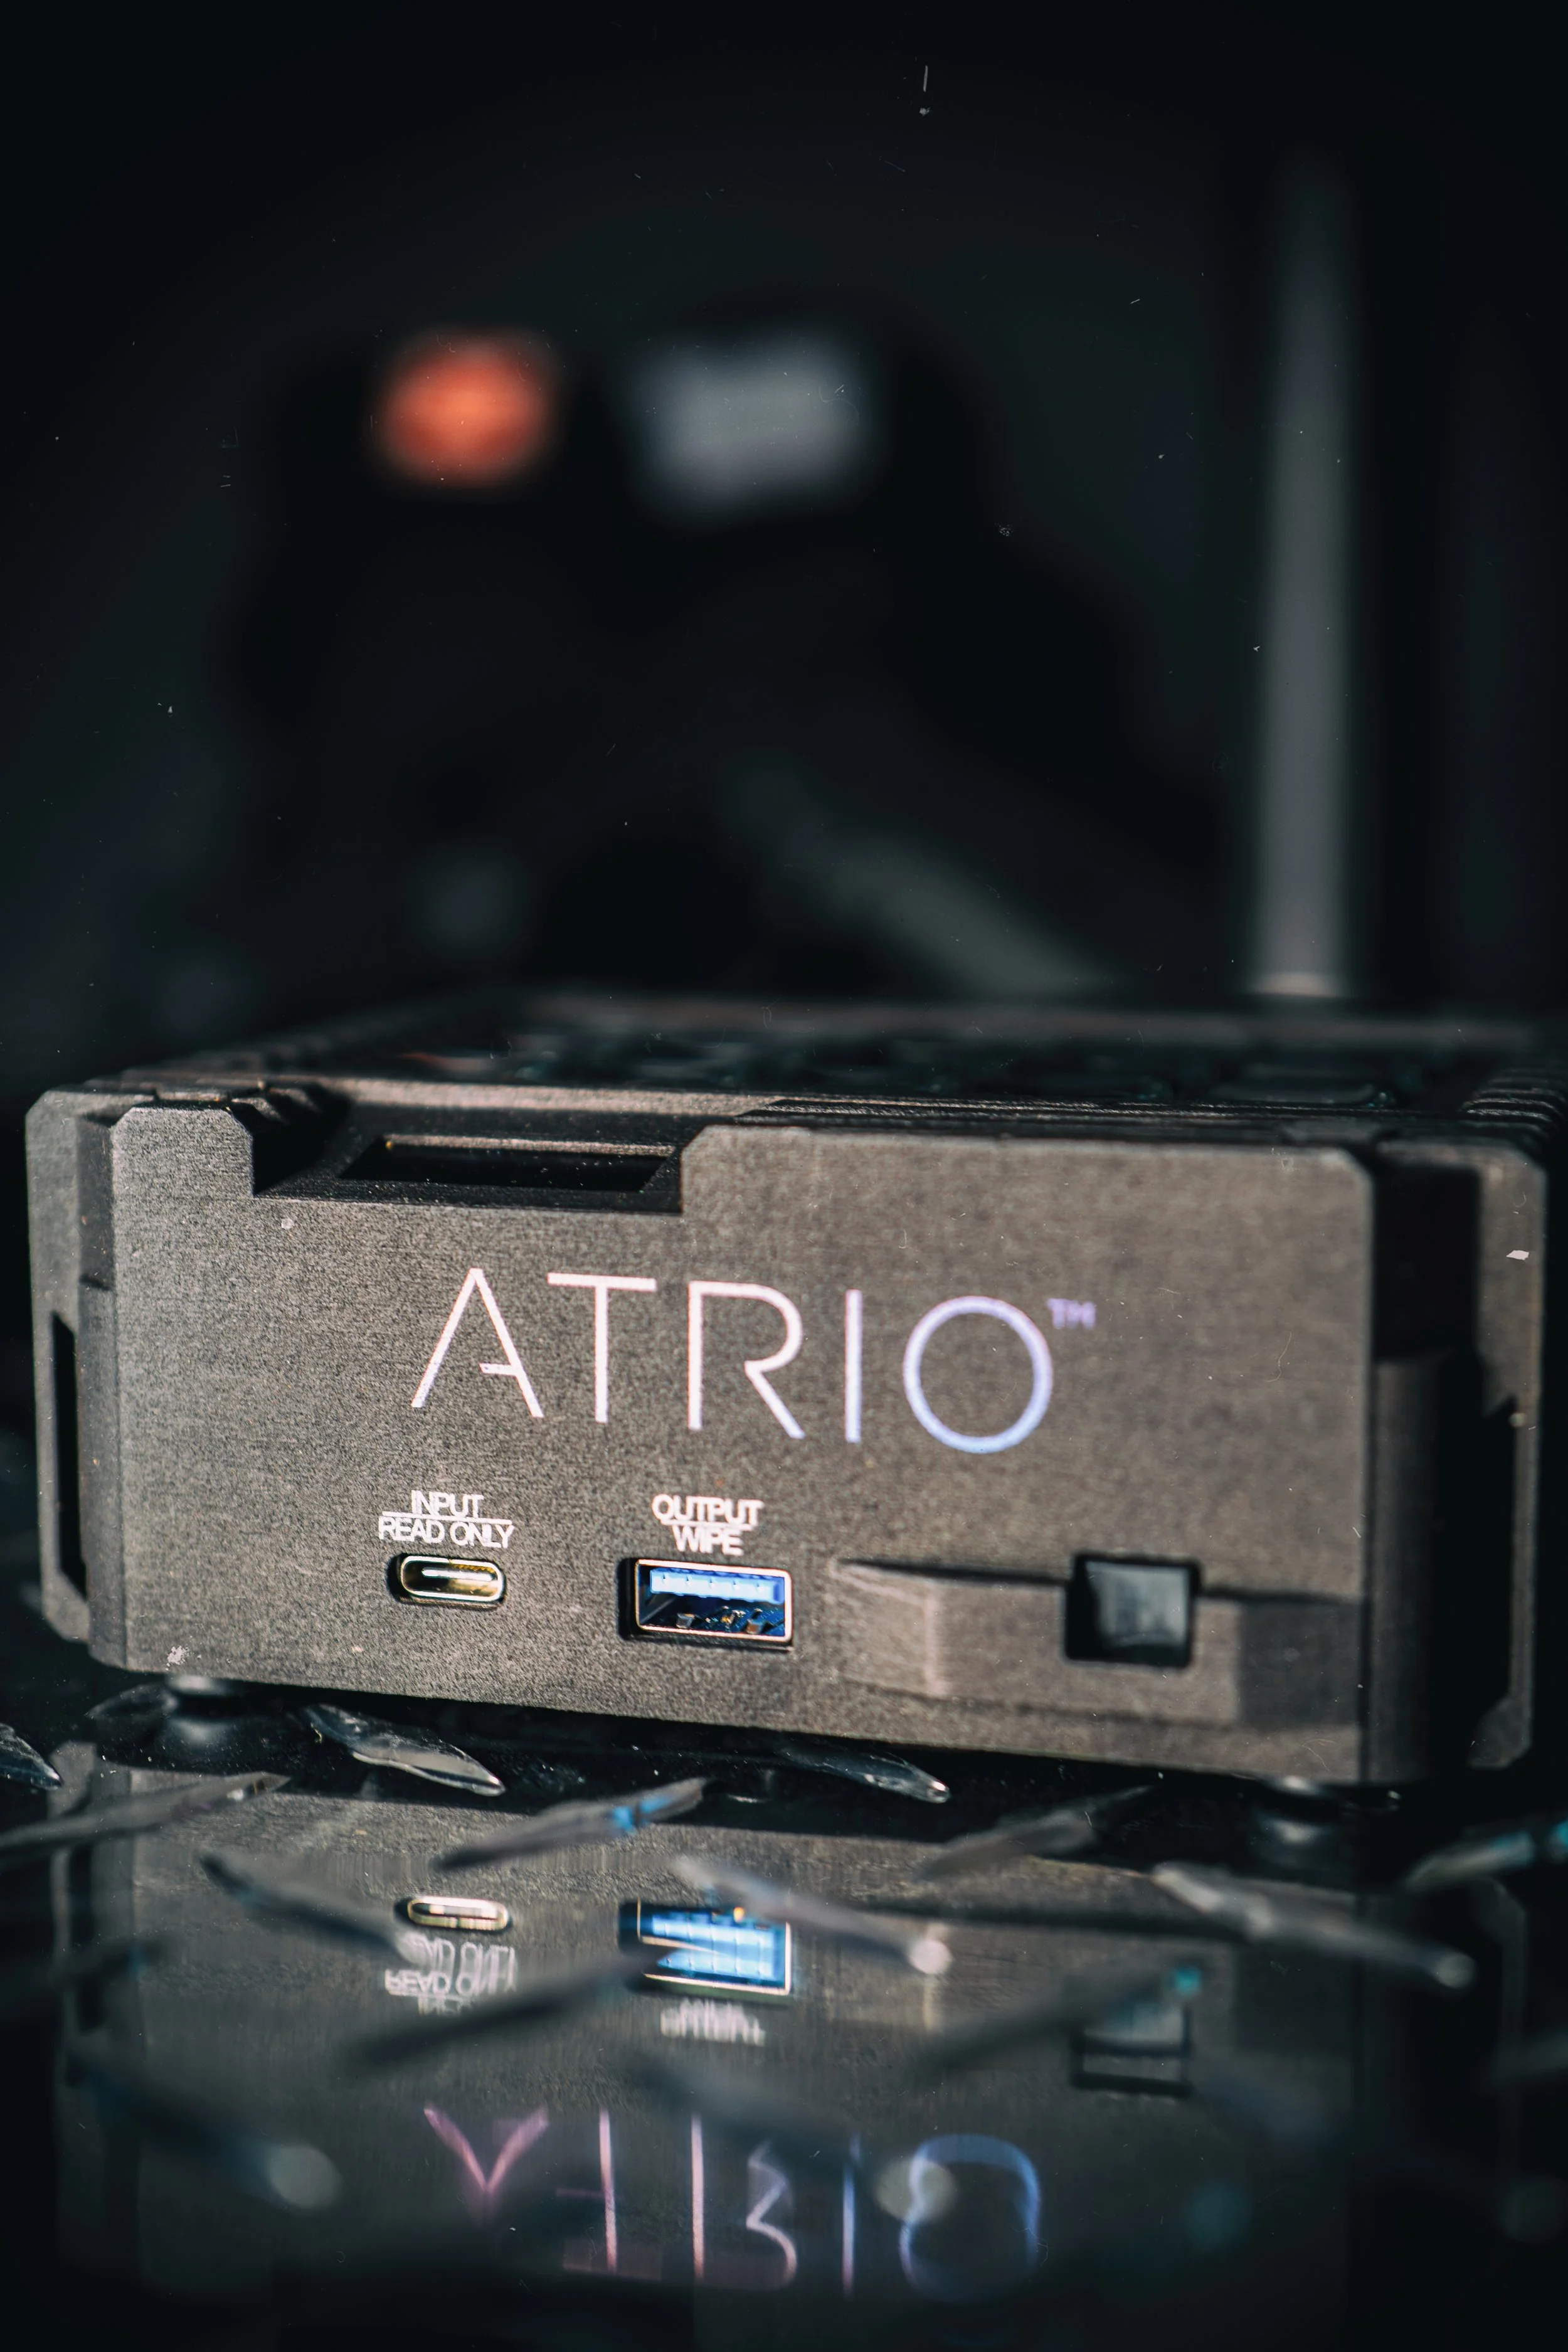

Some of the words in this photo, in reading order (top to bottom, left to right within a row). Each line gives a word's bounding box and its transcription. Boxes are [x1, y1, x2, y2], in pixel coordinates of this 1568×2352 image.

[411, 1490, 484, 1518] INPUT
[652, 1493, 765, 1528] OUTPUT
[378, 1515, 445, 1544] READ
[449, 1522, 516, 1549] ONLY
[672, 1524, 744, 1557] WIPE
